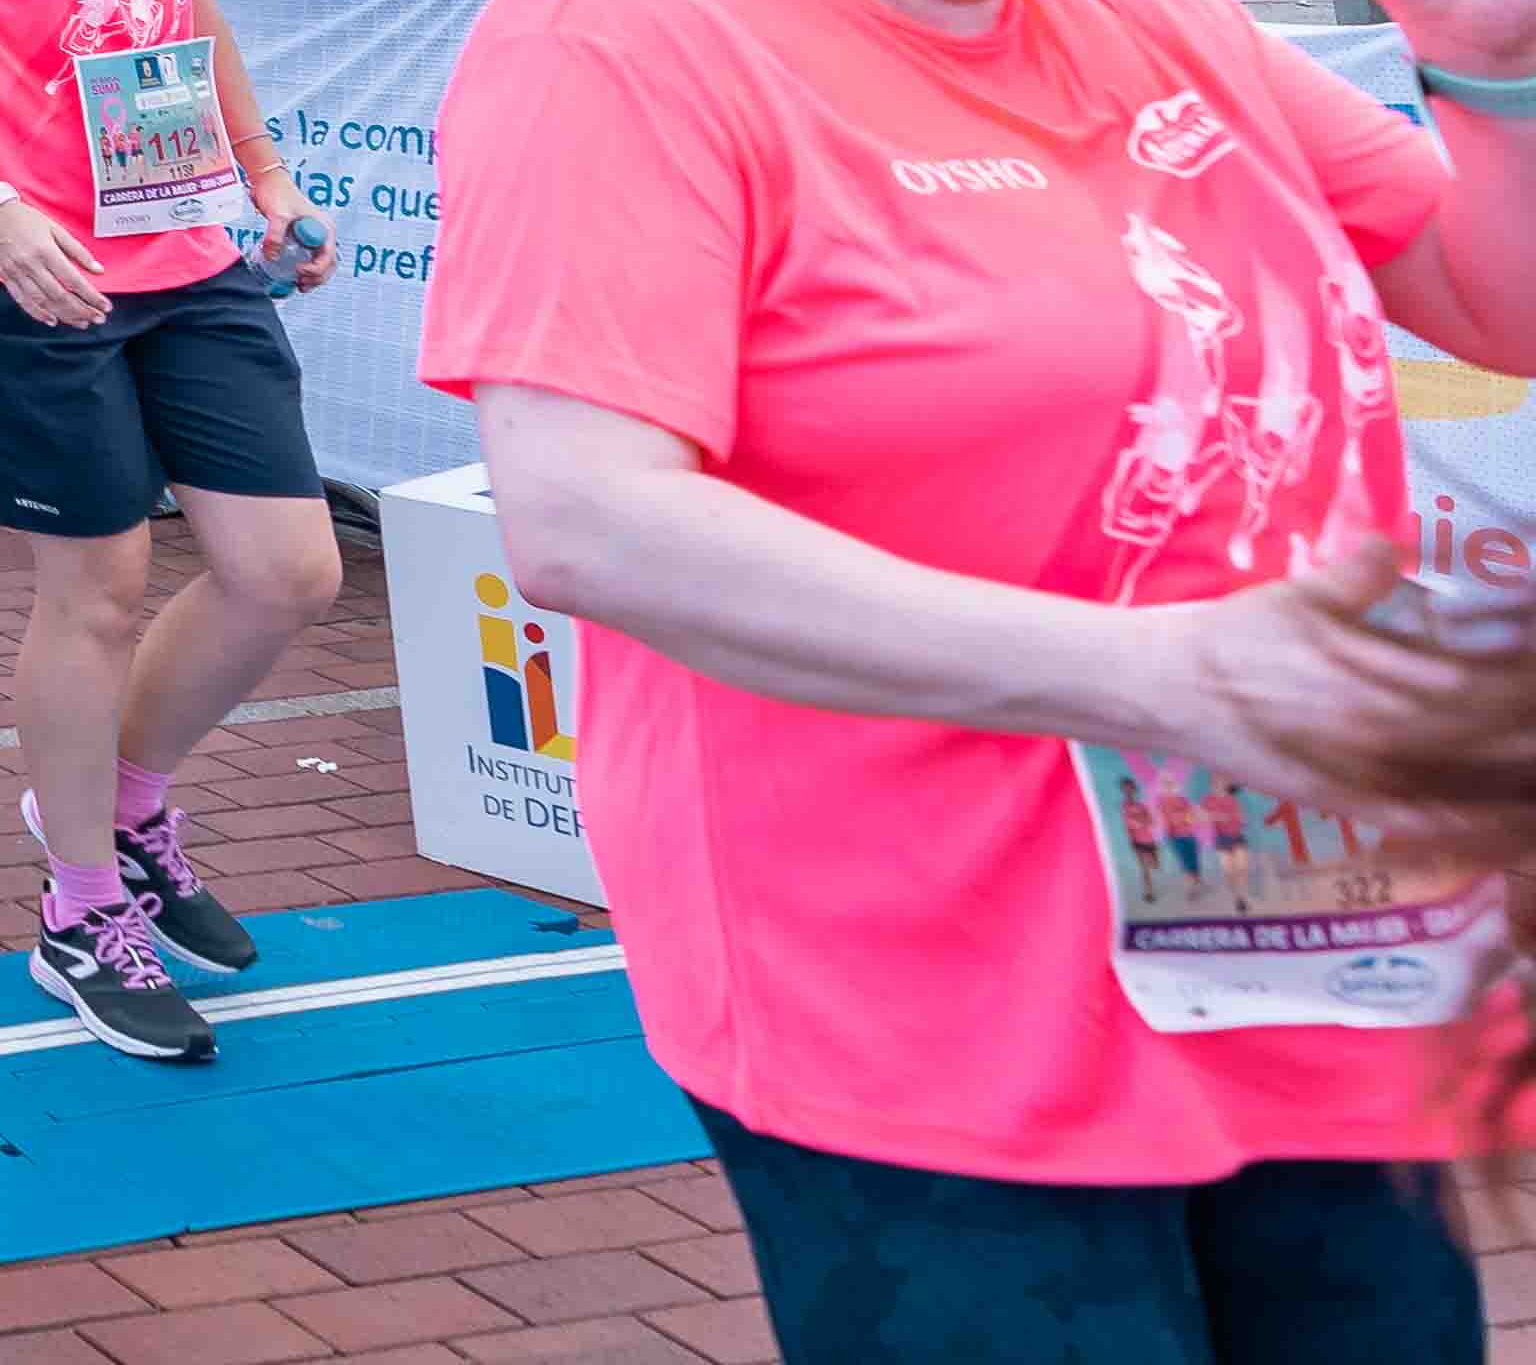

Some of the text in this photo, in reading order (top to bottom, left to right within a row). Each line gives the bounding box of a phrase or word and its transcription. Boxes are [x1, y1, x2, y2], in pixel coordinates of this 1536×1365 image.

[148, 126, 201, 161] 112
[296, 109, 329, 146] la
[891, 158, 1048, 195] OYSHO
